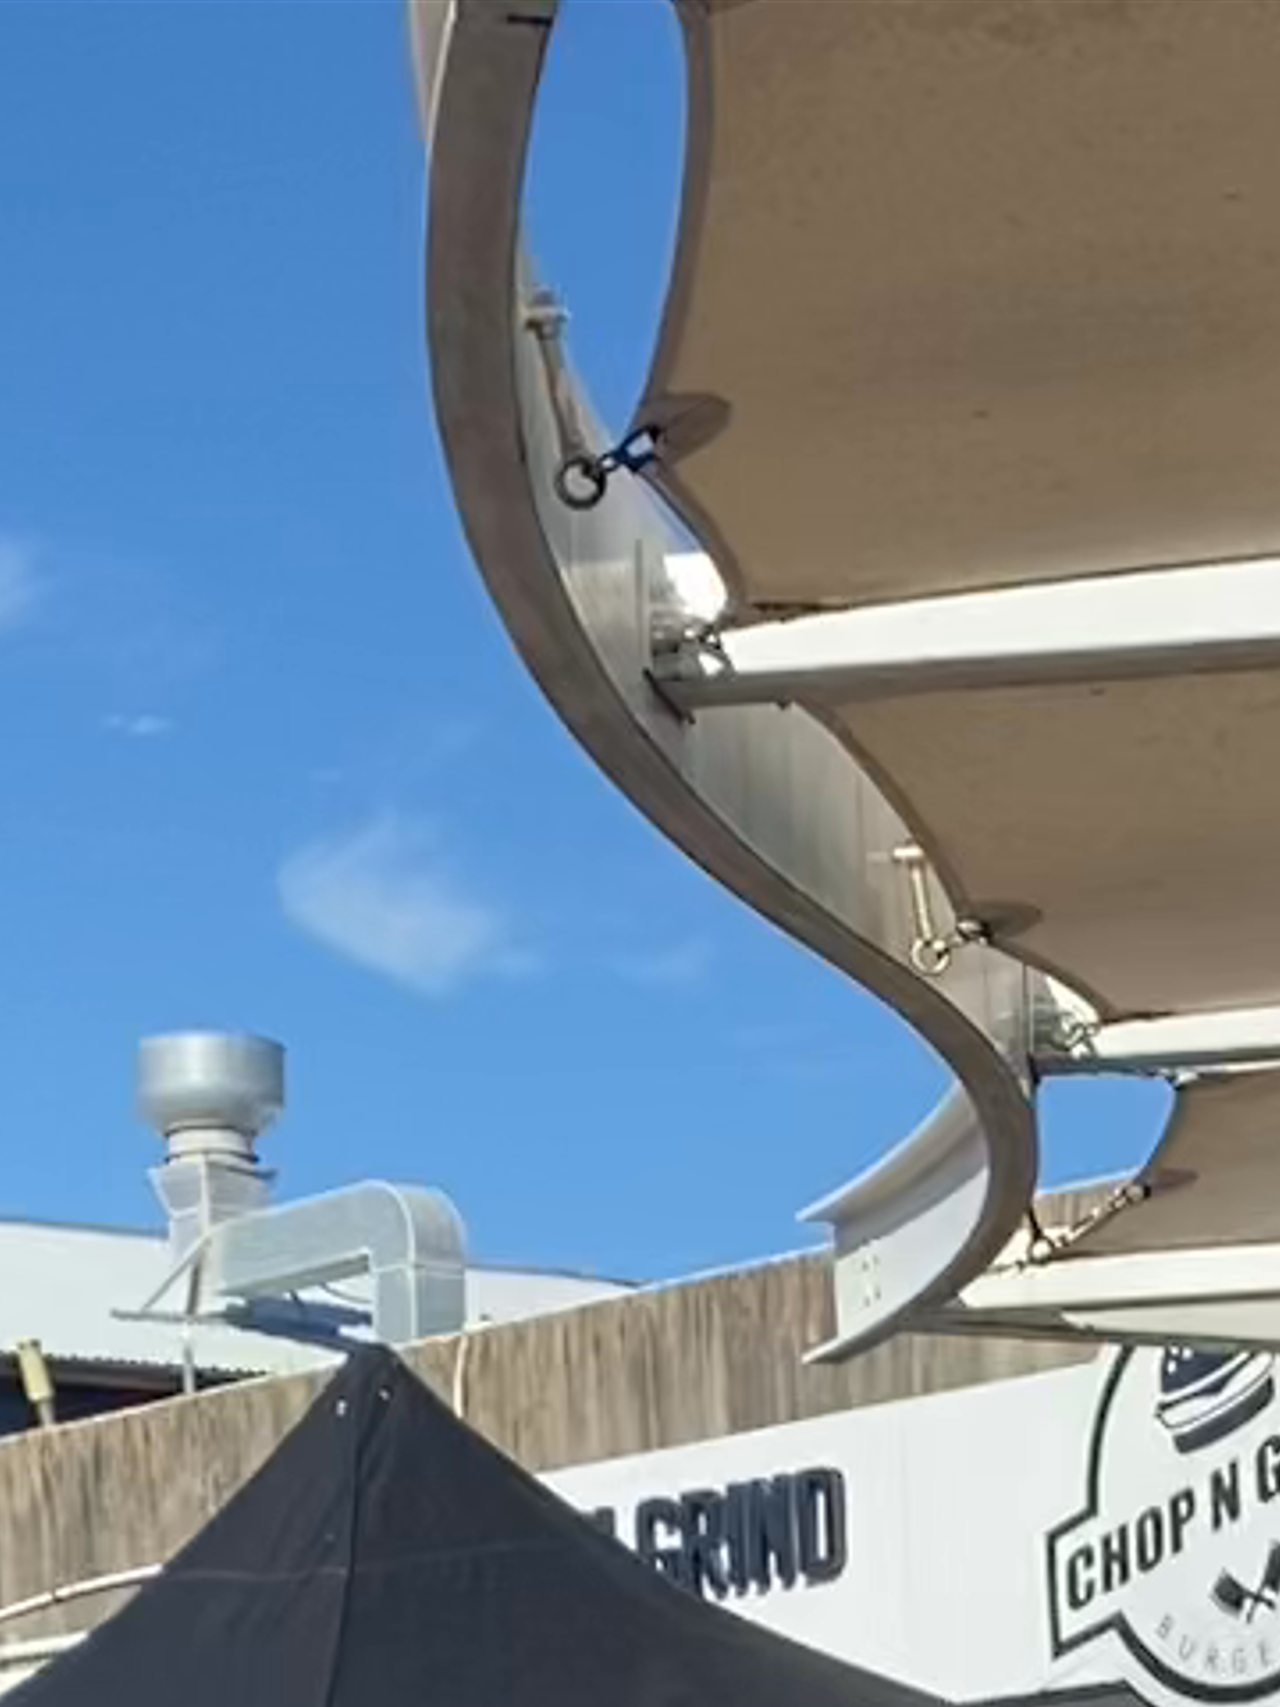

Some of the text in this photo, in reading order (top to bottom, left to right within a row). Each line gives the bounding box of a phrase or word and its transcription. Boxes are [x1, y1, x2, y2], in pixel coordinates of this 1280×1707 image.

[635, 1467, 848, 1602] GRIND
[1066, 1487, 1195, 1612] CHOP
[1210, 1457, 1241, 1531] N
